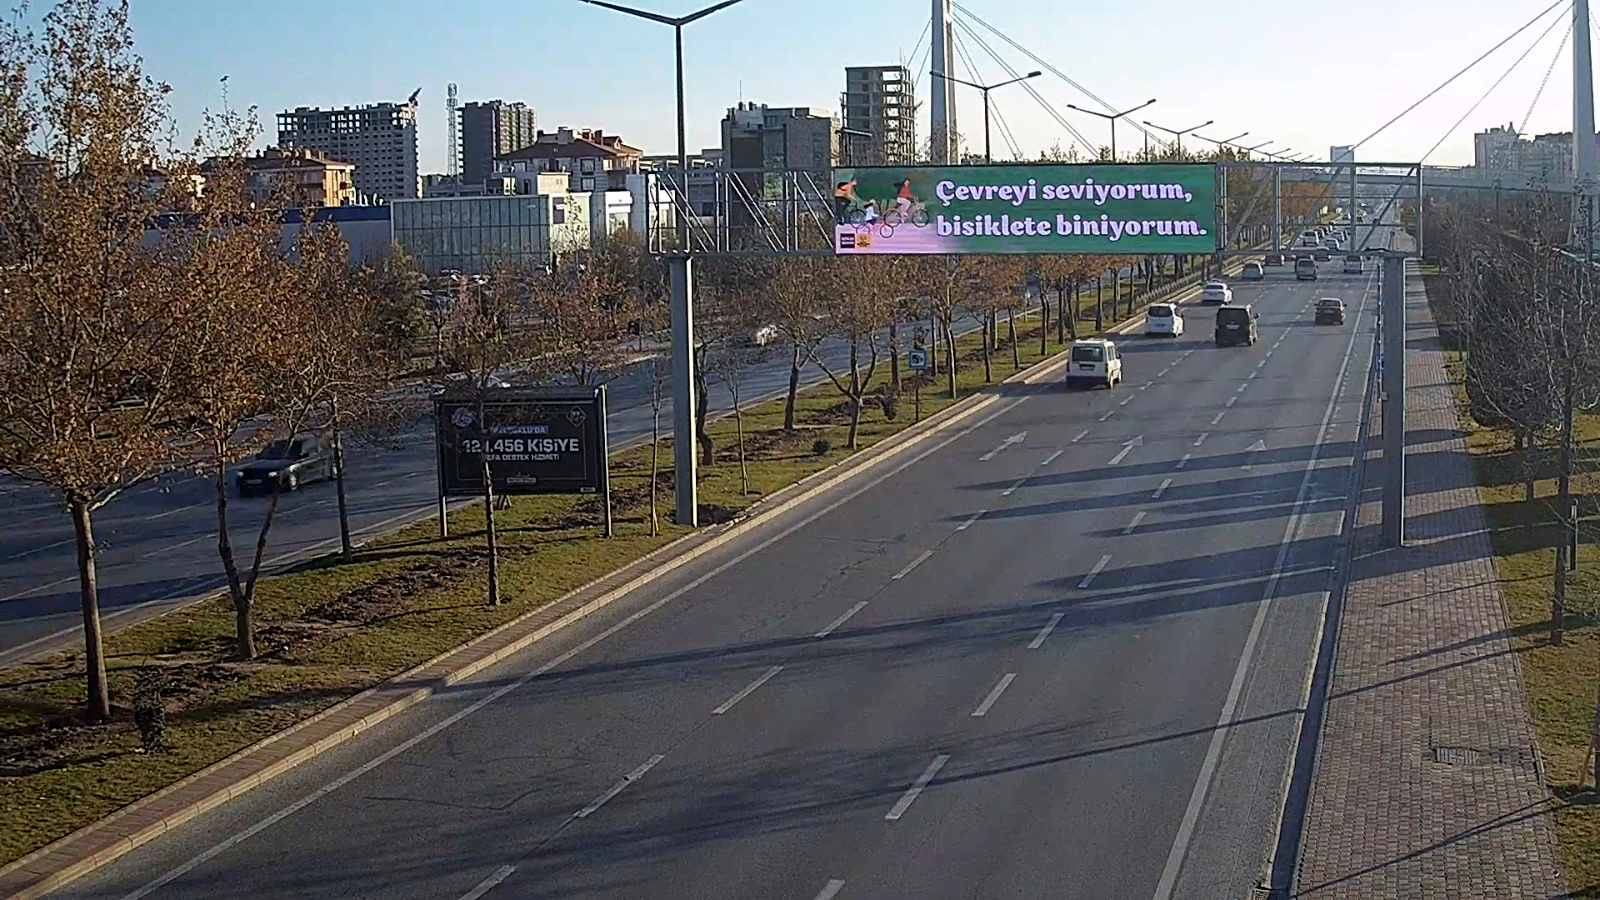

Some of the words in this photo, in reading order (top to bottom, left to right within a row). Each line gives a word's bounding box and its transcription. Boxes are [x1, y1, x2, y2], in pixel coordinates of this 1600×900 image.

[936, 178, 1037, 207] Çevreyi
[1042, 178, 1193, 206] seviyorum,
[936, 214, 1052, 237] bisiklete
[1056, 213, 1208, 241] biniyorum.
